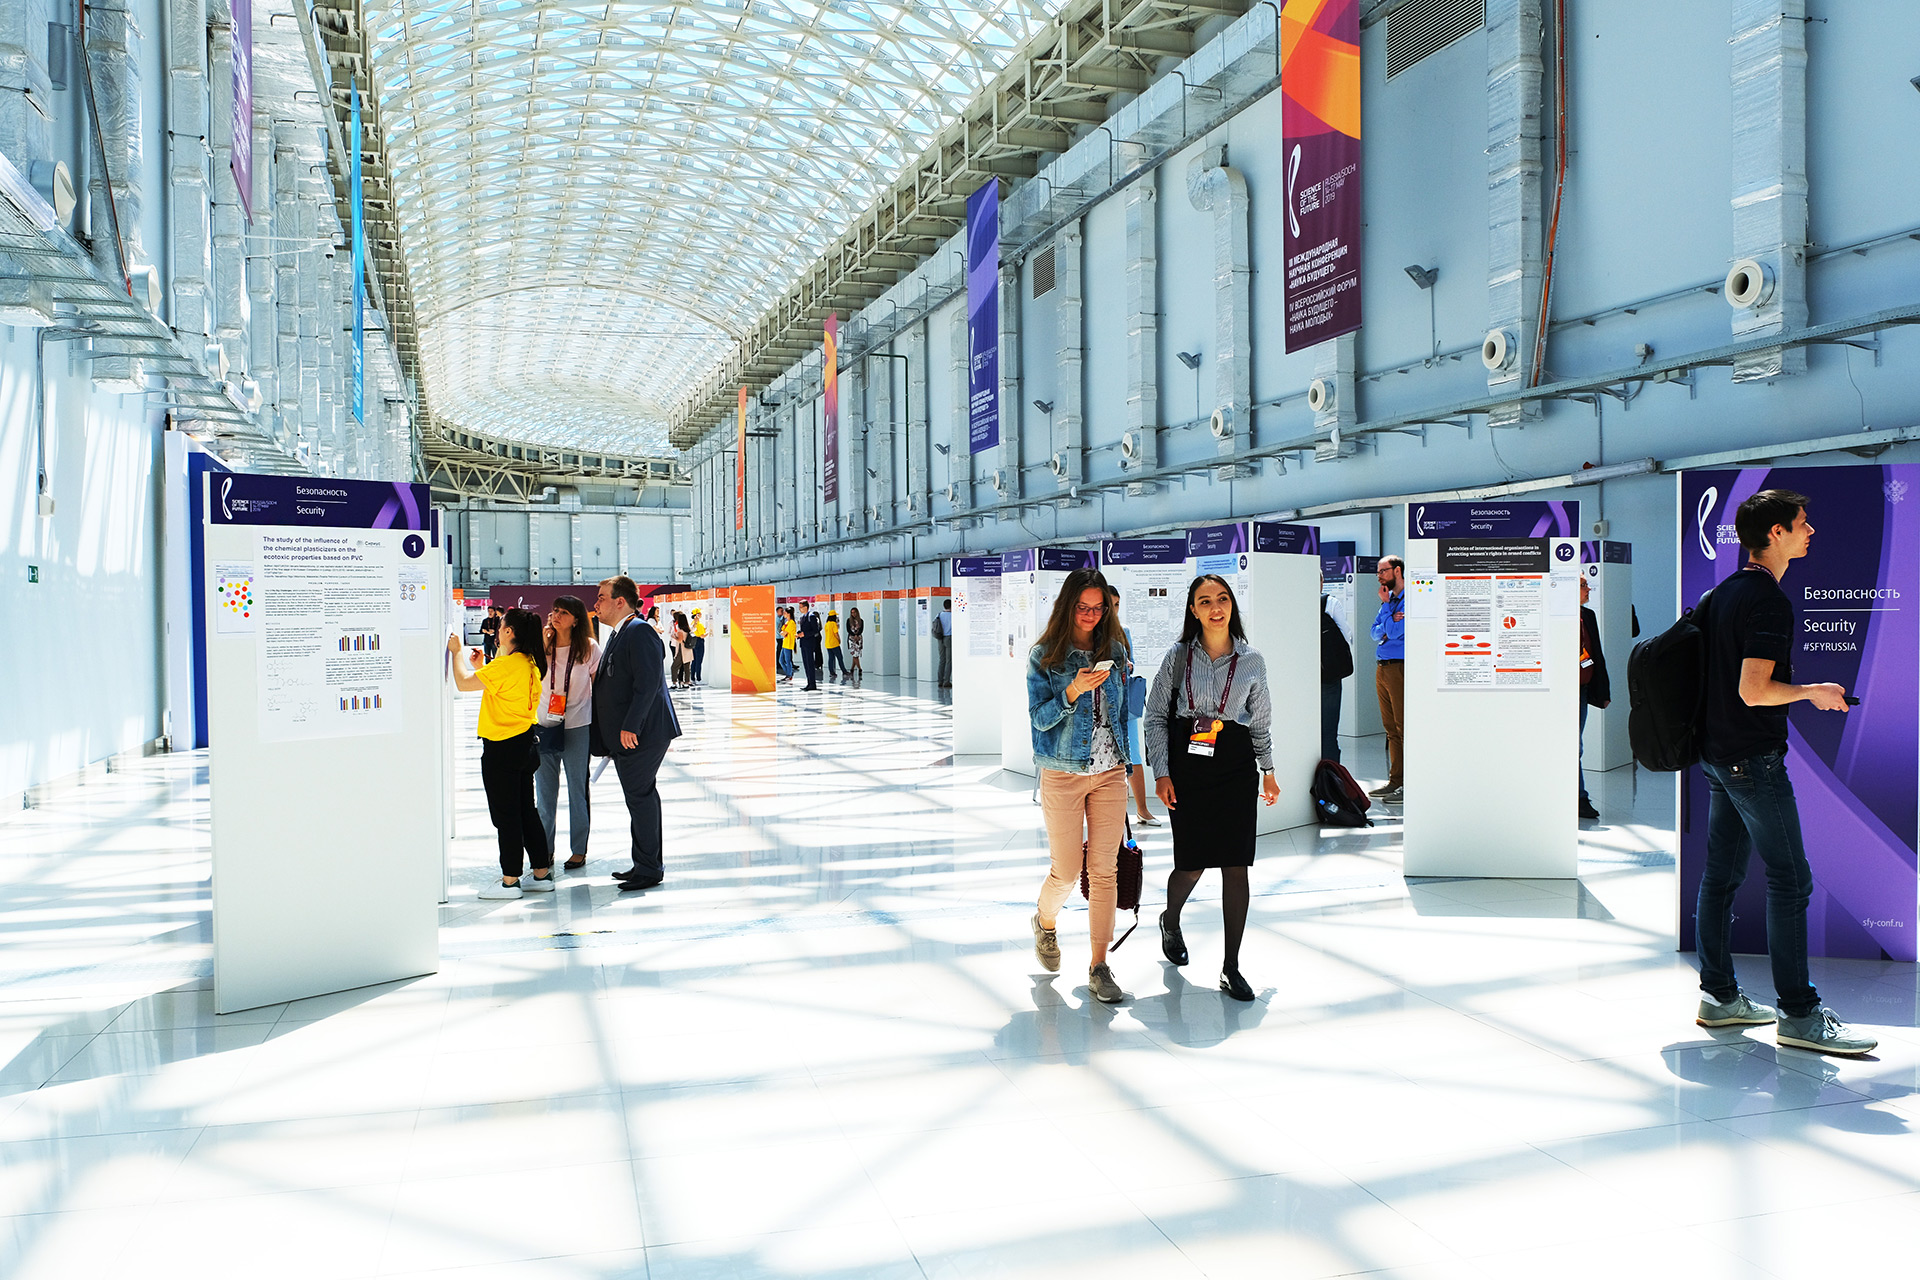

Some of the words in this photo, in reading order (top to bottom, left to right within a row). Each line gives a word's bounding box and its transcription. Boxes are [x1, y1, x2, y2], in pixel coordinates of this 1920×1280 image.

[1300, 182, 1321, 199] SCIENCE
[1300, 198, 1307, 207] OF
[1308, 193, 1317, 203] THE
[1300, 200, 1320, 216] FUTURE
[1294, 237, 1338, 265] МЕЖДУНАРОДНАЯ
[1289, 262, 1311, 279] НАУЧНАЯ
[1311, 245, 1347, 269] КОНФЕРЕНЦИЯ
[1295, 284, 1336, 307] ВСЕРОССИЙСКИЙ
[1337, 277, 1357, 293] ФОРУМ
[1289, 322, 1305, 334] НАУКА
[296, 486, 348, 497] Безопасность
[296, 506, 325, 517] Security
[1470, 523, 1493, 531] Security
[276, 537, 293, 545] study
[411, 541, 417, 552] 1
[303, 546, 337, 554] plasticizers
[1803, 586, 1900, 600] Безопасность
[1803, 619, 1857, 635] Security
[1803, 642, 1857, 651] #SFYRUSSIA
[1862, 917, 1904, 928] sfy-conf.ru
